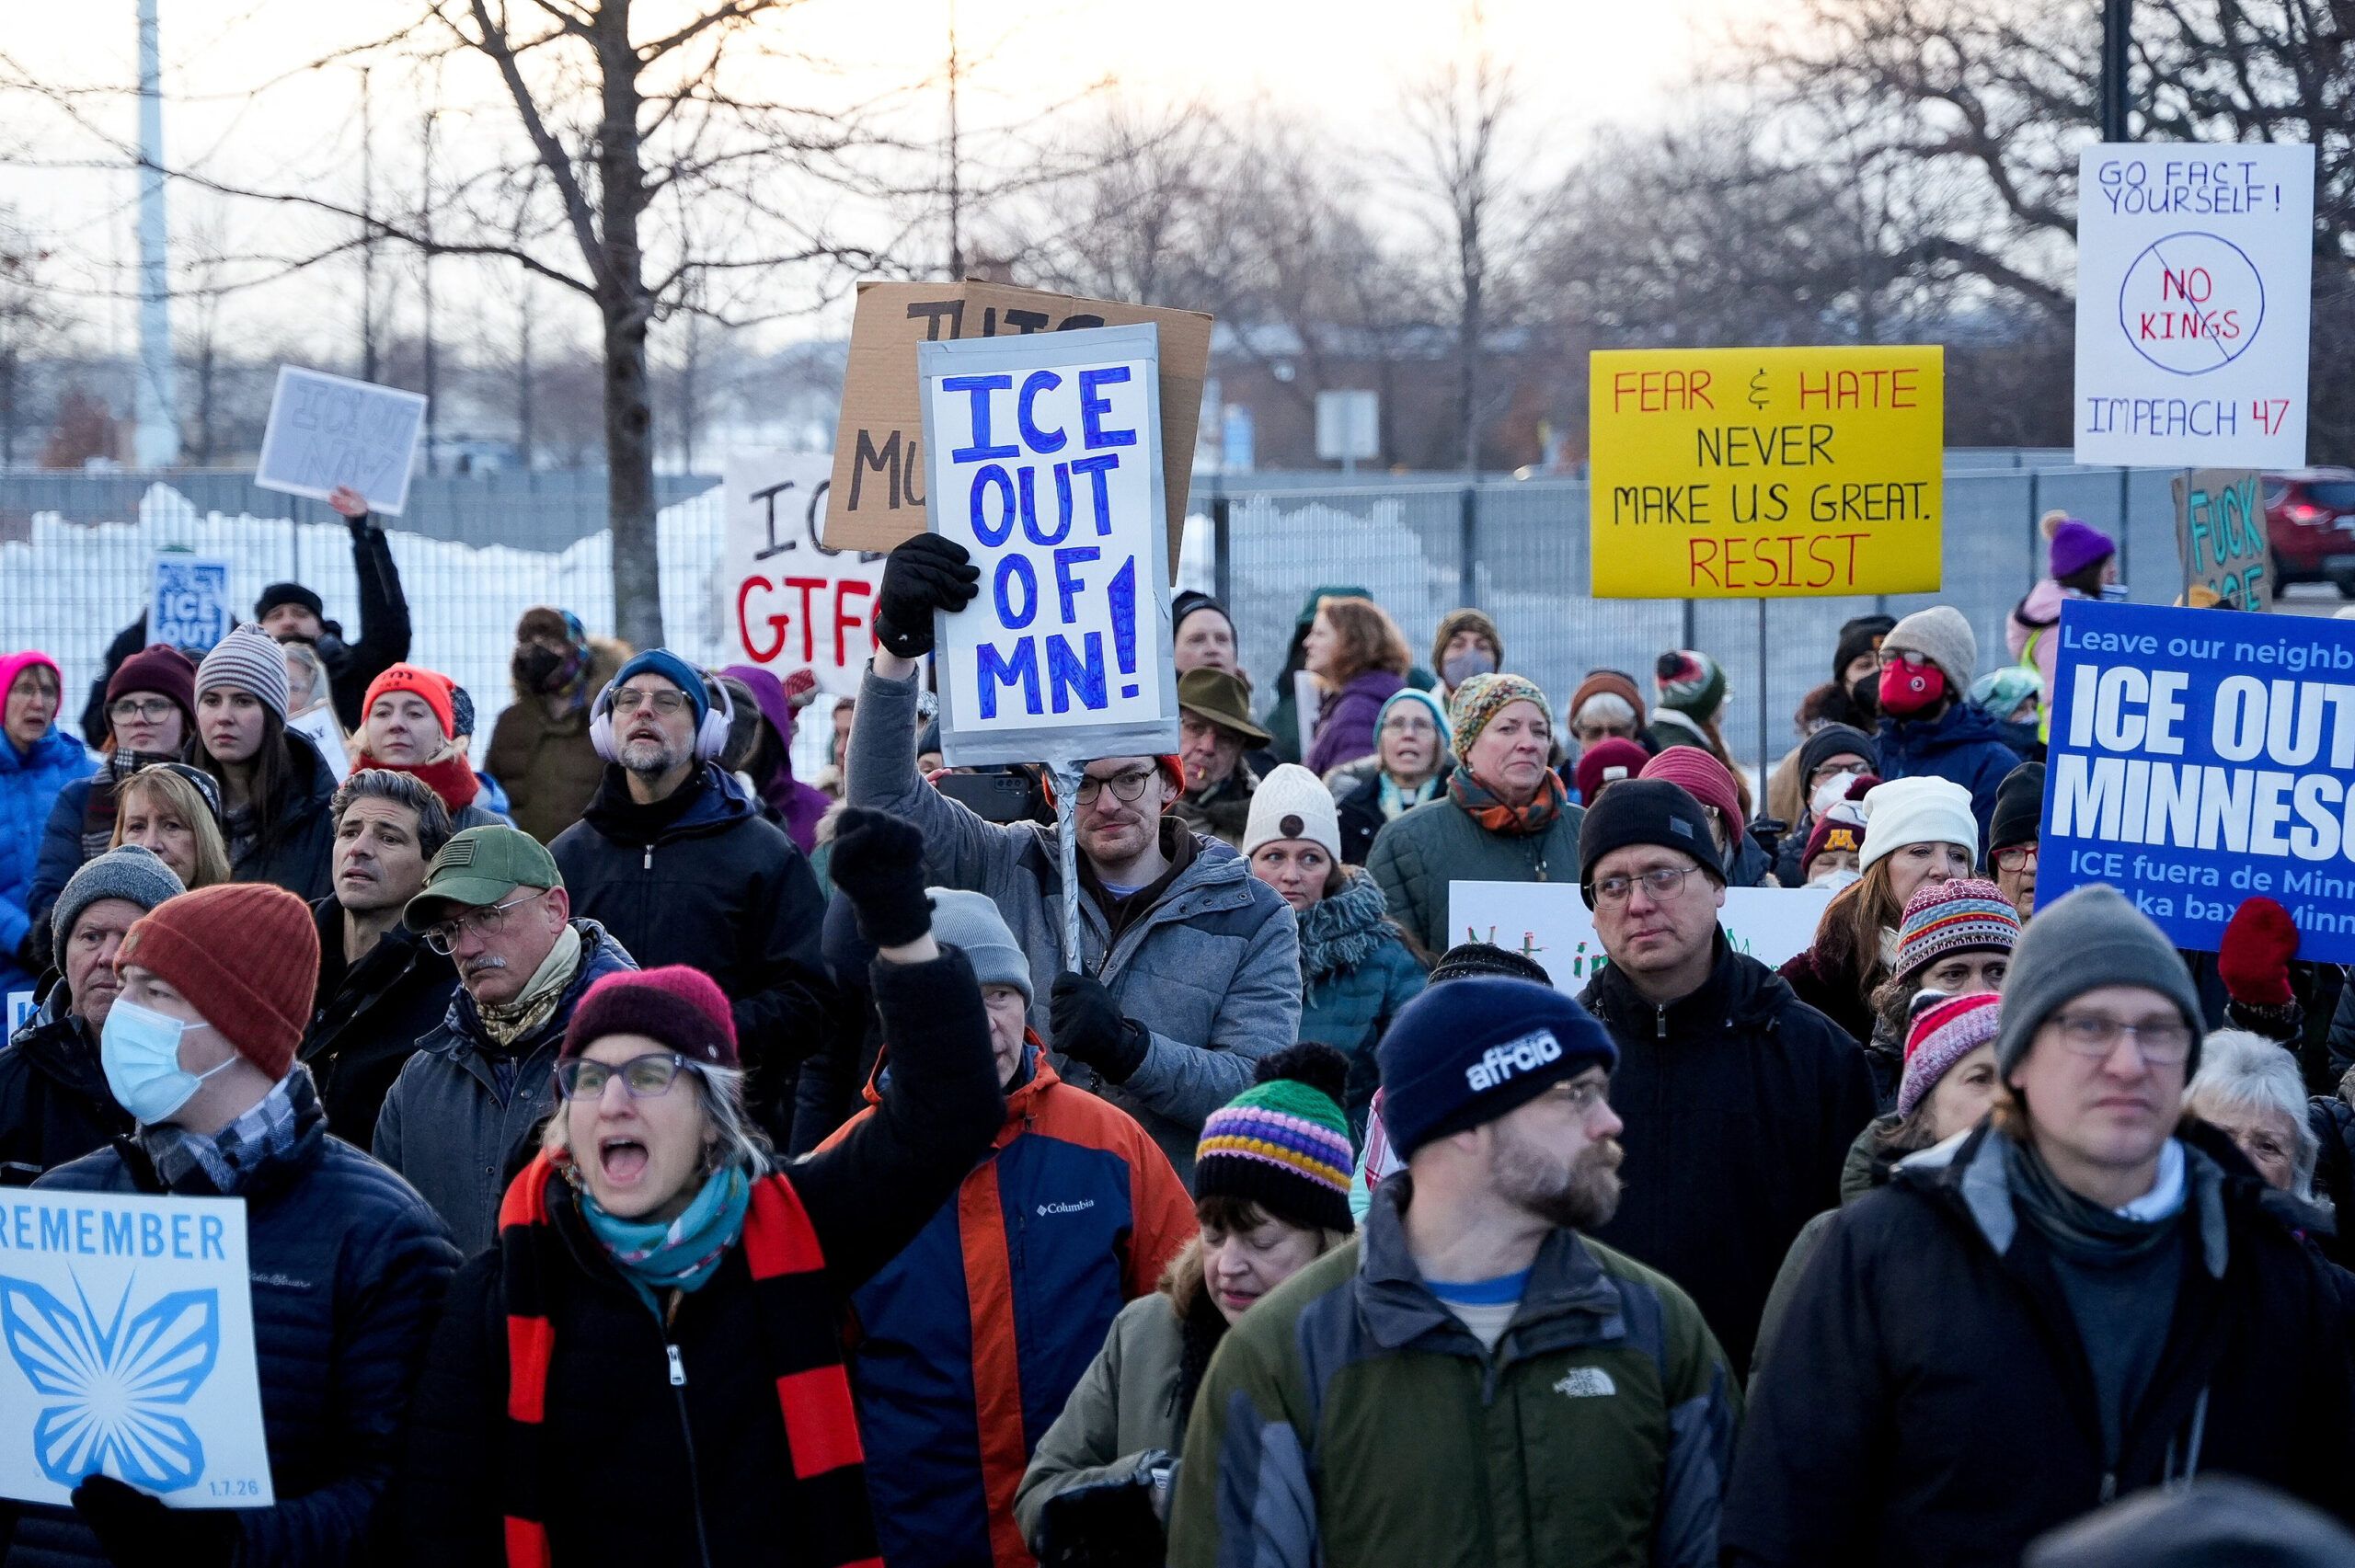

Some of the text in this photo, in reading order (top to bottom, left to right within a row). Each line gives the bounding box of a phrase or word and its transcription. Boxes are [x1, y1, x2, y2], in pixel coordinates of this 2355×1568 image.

[2099, 160, 2257, 185] GO FACT
[2163, 267, 2211, 303] NO
[2141, 310, 2240, 340] KINGS
[1614, 370, 1715, 413] FEAR
[1800, 368, 1919, 410] HATE
[942, 366, 1137, 464] ICE
[2086, 397, 2290, 436] IMPEACH 47
[1697, 425, 1835, 467] NEVER
[749, 479, 892, 564] IC
[970, 453, 1120, 548] OUT
[1614, 482, 1931, 524] MAKE US GREAT.
[2189, 477, 2263, 575] FUCK
[1689, 534, 1871, 588] RESIST
[165, 592, 216, 620] ICE
[993, 546, 1101, 629] OF
[160, 620, 216, 649] OUT
[738, 575, 880, 667] GTF
[2063, 624, 2158, 654] Leave
[2167, 638, 2224, 659] our
[2069, 663, 2355, 770] ICE OUT
[2051, 753, 2355, 863] MINNES
[1824, 829, 1857, 851] M
[2070, 849, 2124, 878] ICE
[2132, 854, 2220, 887] fuera
[2230, 864, 2272, 892] de
[2135, 888, 2174, 918] ka
[1047, 1198, 1094, 1214] Columbia
